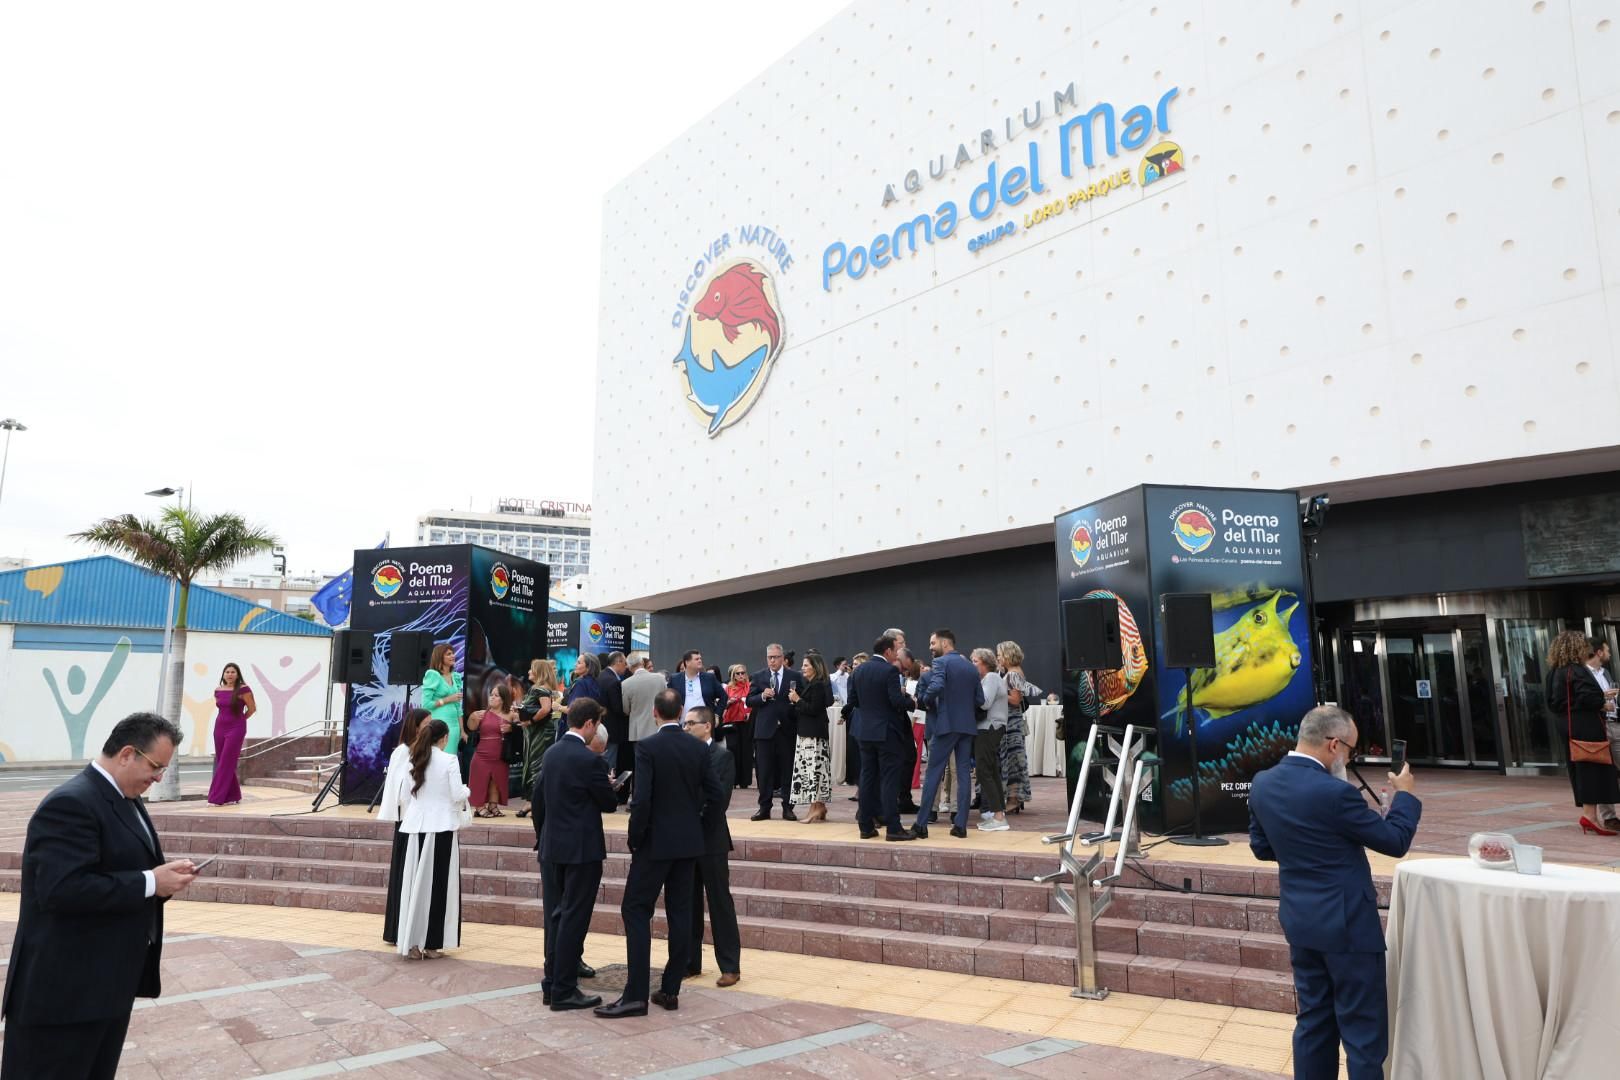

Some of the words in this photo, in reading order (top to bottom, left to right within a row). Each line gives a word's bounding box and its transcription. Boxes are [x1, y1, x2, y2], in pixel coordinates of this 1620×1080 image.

[881, 81, 1077, 209] AQUARIUM
[822, 201, 959, 292] Poema
[969, 138, 1045, 222] del
[1058, 86, 1178, 179] Mar
[967, 221, 1016, 253] GRUPO
[1023, 198, 1065, 229] LORO
[1066, 168, 1132, 210] PARQUE
[672, 232, 732, 329] DISCOVER
[738, 223, 795, 276] NATURE
[498, 496, 536, 509] HOTEL
[540, 500, 592, 513] CRISTINA
[1169, 501, 1194, 521] DISCOVER
[1196, 503, 1218, 522] NATURE
[1094, 515, 1128, 535] Poema
[1222, 508, 1279, 528] Poema
[1096, 534, 1109, 550] del
[1111, 530, 1128, 546] Mar
[1223, 527, 1247, 543] del
[1251, 528, 1280, 543] Mar
[1224, 546, 1281, 555] AQUARIUM
[371, 559, 390, 575] DISCOVER
[409, 562, 453, 576] Poema
[409, 576, 426, 588] del
[429, 575, 453, 587] Mar
[511, 569, 534, 586] Poema
[408, 589, 452, 597] AQUARIUM
[511, 583, 521, 595] del
[522, 584, 534, 597] Mar
[604, 622, 625, 632] Poema
[1221, 782, 1234, 790] PEZ
